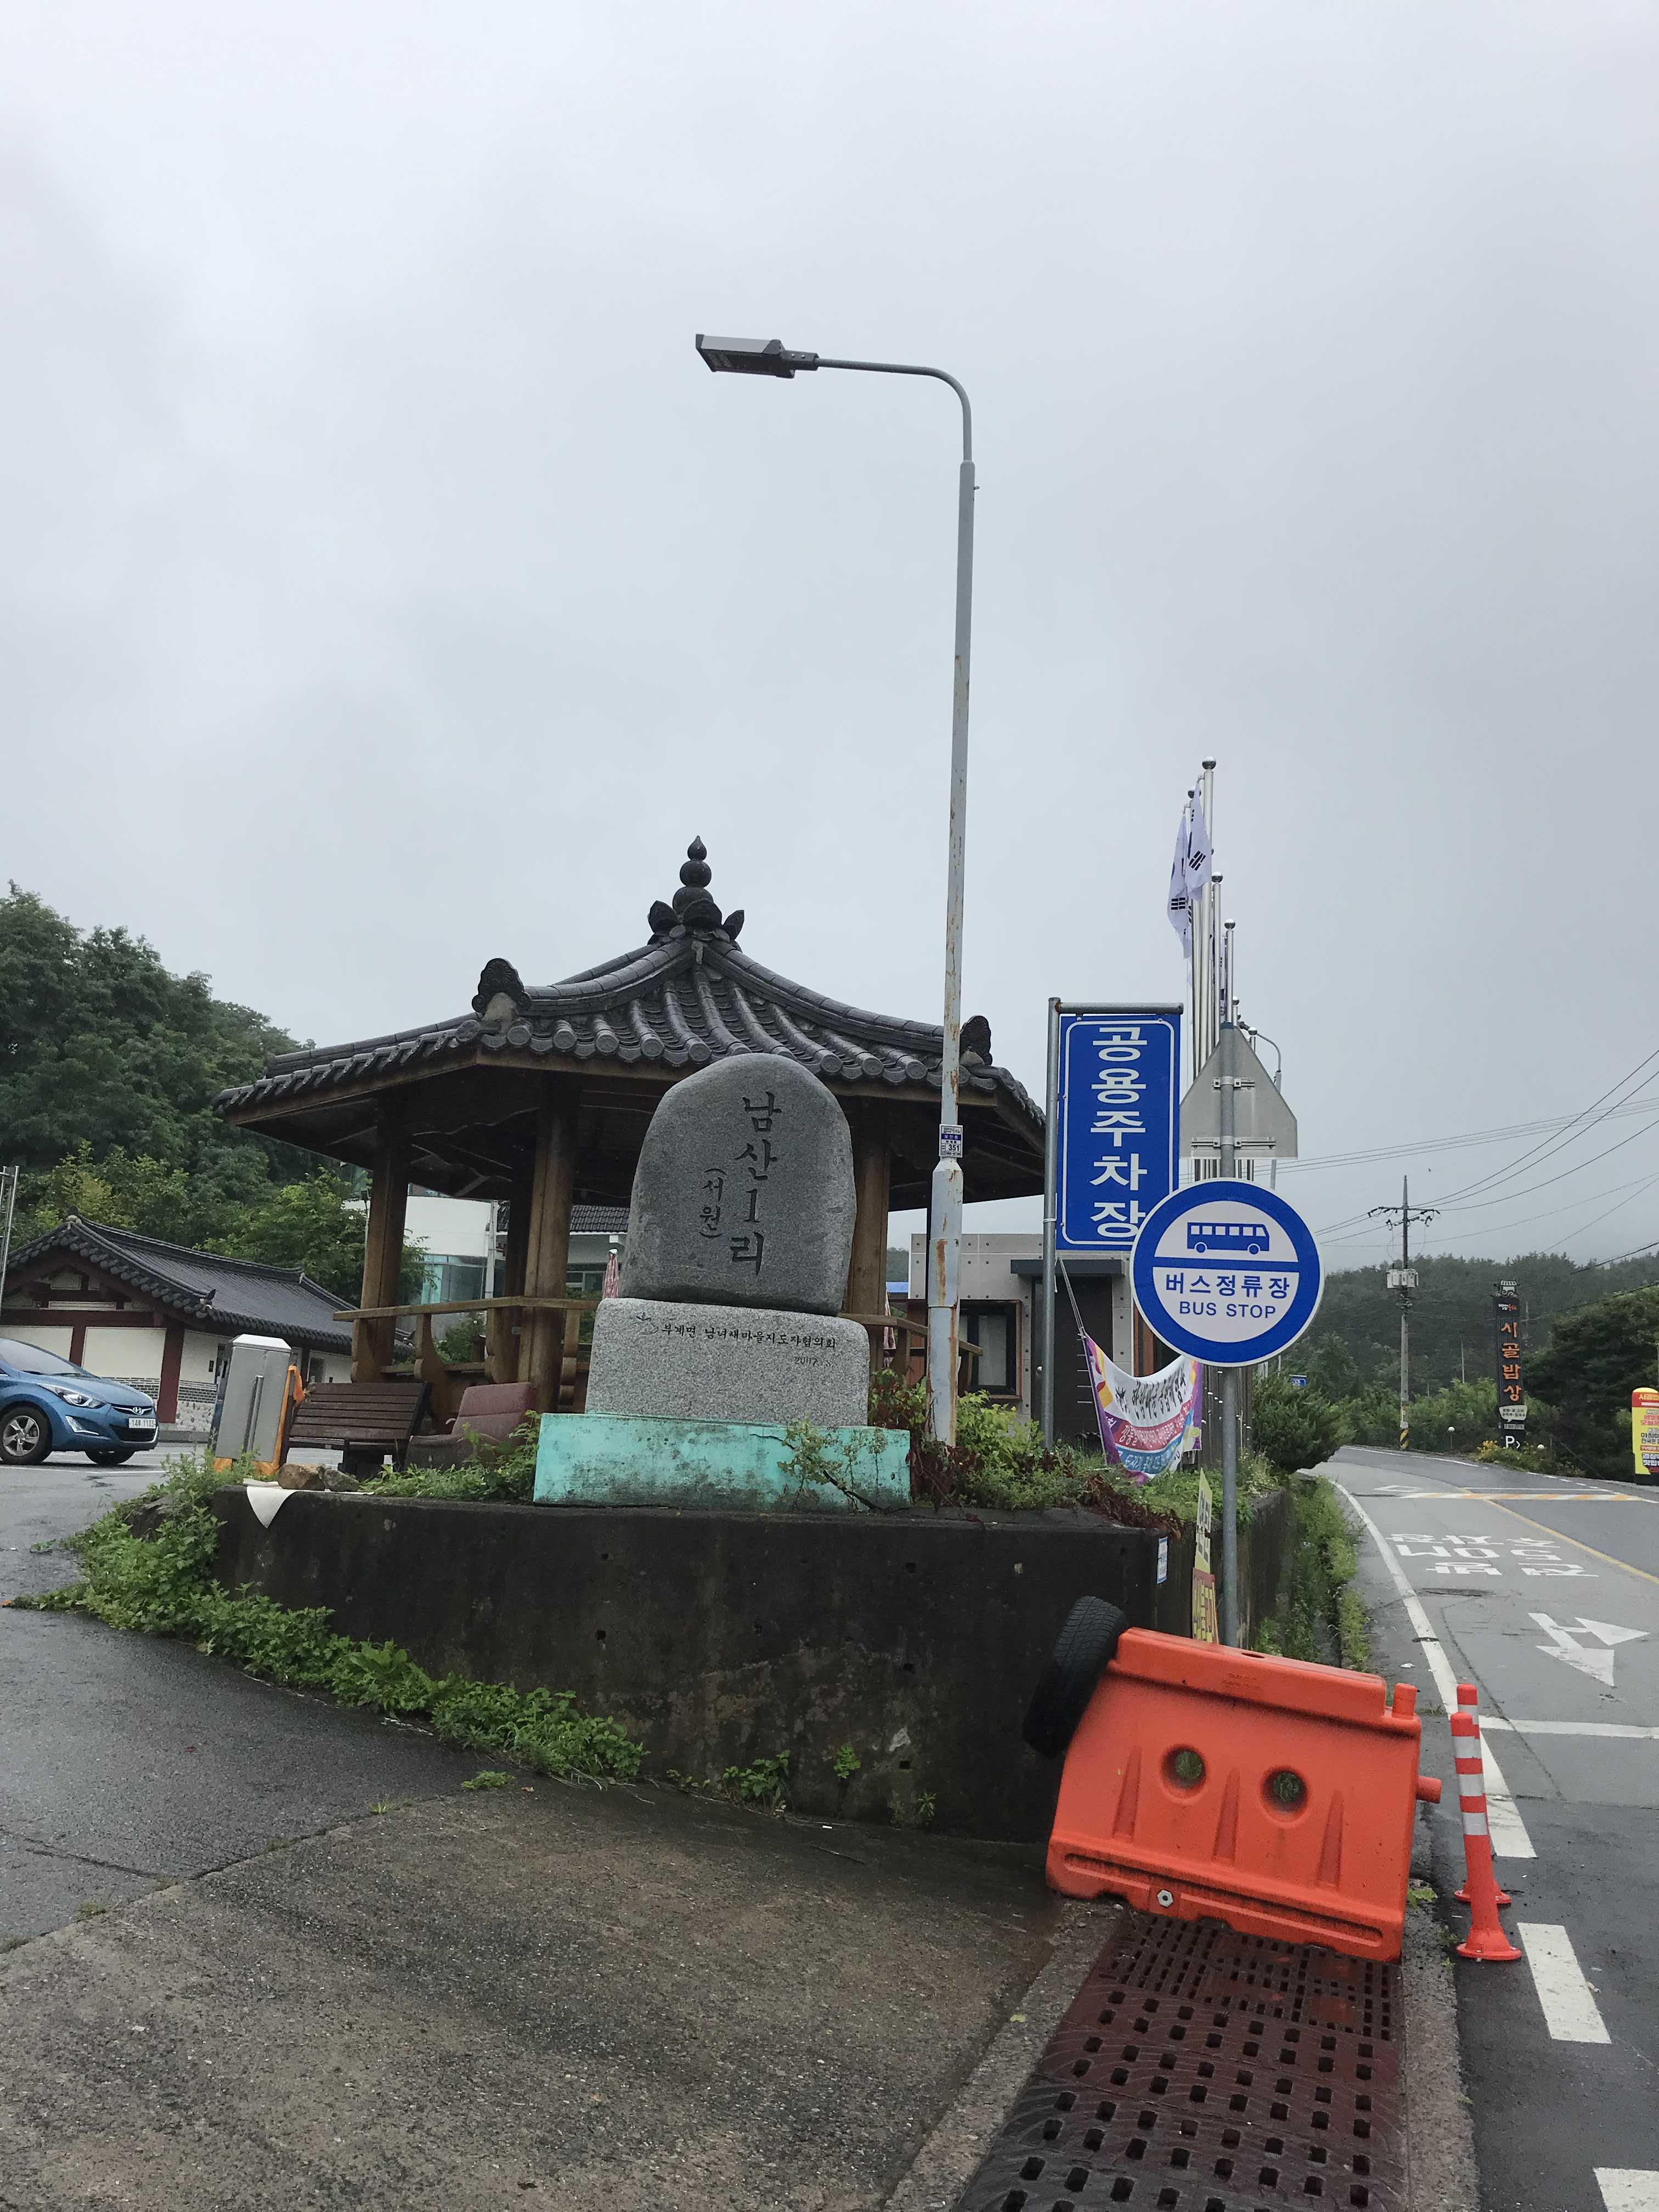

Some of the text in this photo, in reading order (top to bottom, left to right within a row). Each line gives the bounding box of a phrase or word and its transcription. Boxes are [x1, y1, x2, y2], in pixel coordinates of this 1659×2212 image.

[1090, 1027, 1147, 1238] 공용주차장
[699, 1168, 727, 1238] (서원)
[731, 1091, 782, 1276] 남산1리
[1166, 1272, 1290, 1299] 버스정류장
[1180, 1301, 1276, 1318] BUS STOP
[662, 1324, 697, 1338] 부계면
[1500, 1322, 1522, 1402] 시골밥상
[1505, 1435, 1515, 1448] P
